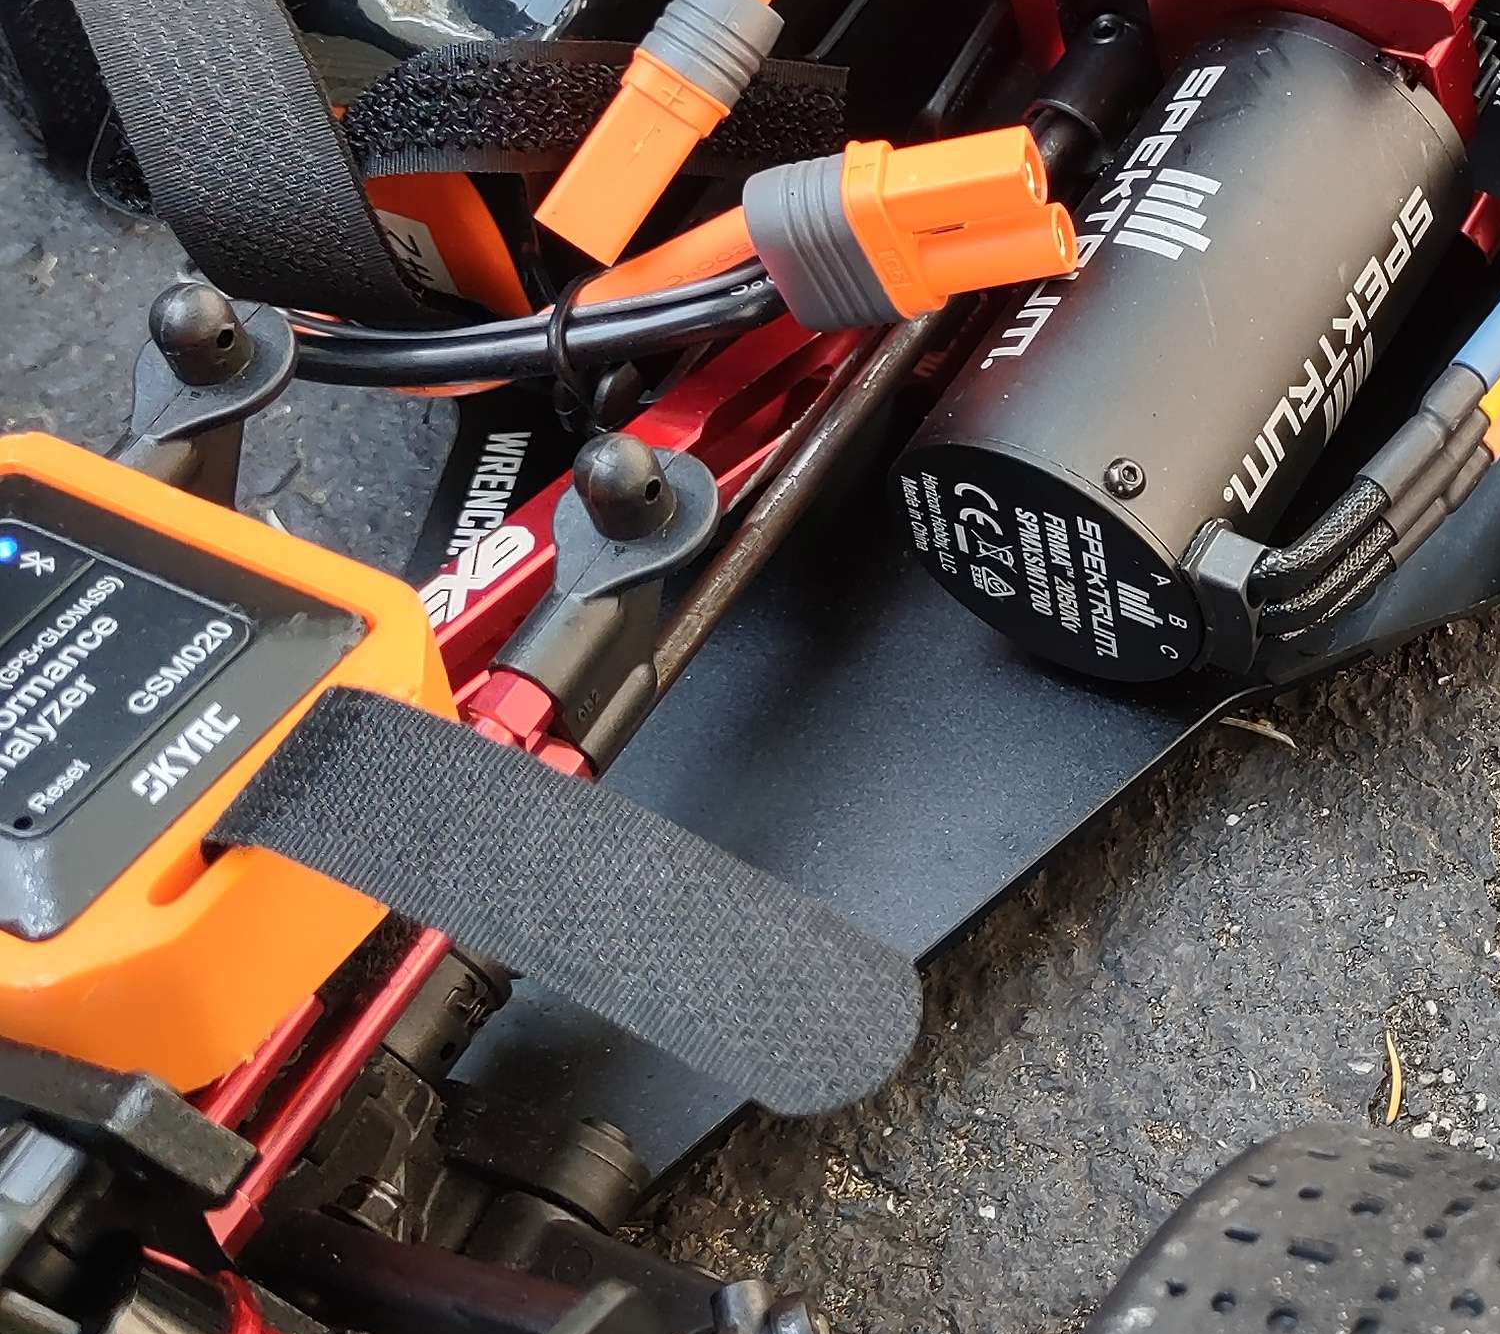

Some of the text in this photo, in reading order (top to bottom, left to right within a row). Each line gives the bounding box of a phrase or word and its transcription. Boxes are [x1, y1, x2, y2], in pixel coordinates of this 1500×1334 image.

[900, 475, 919, 507] Made
[912, 520, 929, 552] China
[921, 471, 940, 515] Horizon
[939, 548, 957, 575] LLC
[954, 482, 1004, 536] CE
[1014, 507, 1054, 617] SPMXSM1700
[1150, 572, 1171, 587] A
[0, 575, 125, 691] (GPS+GLONASS)
[1053, 576, 1080, 635] 2050Kv
[1168, 613, 1188, 629] B
[0, 616, 118, 732] ormance
[128, 620, 233, 715] GSM020
[1160, 644, 1179, 660] C
[0, 673, 97, 784] nalyzer
[131, 701, 241, 805] SKYRC
[27, 758, 92, 814] Reset
